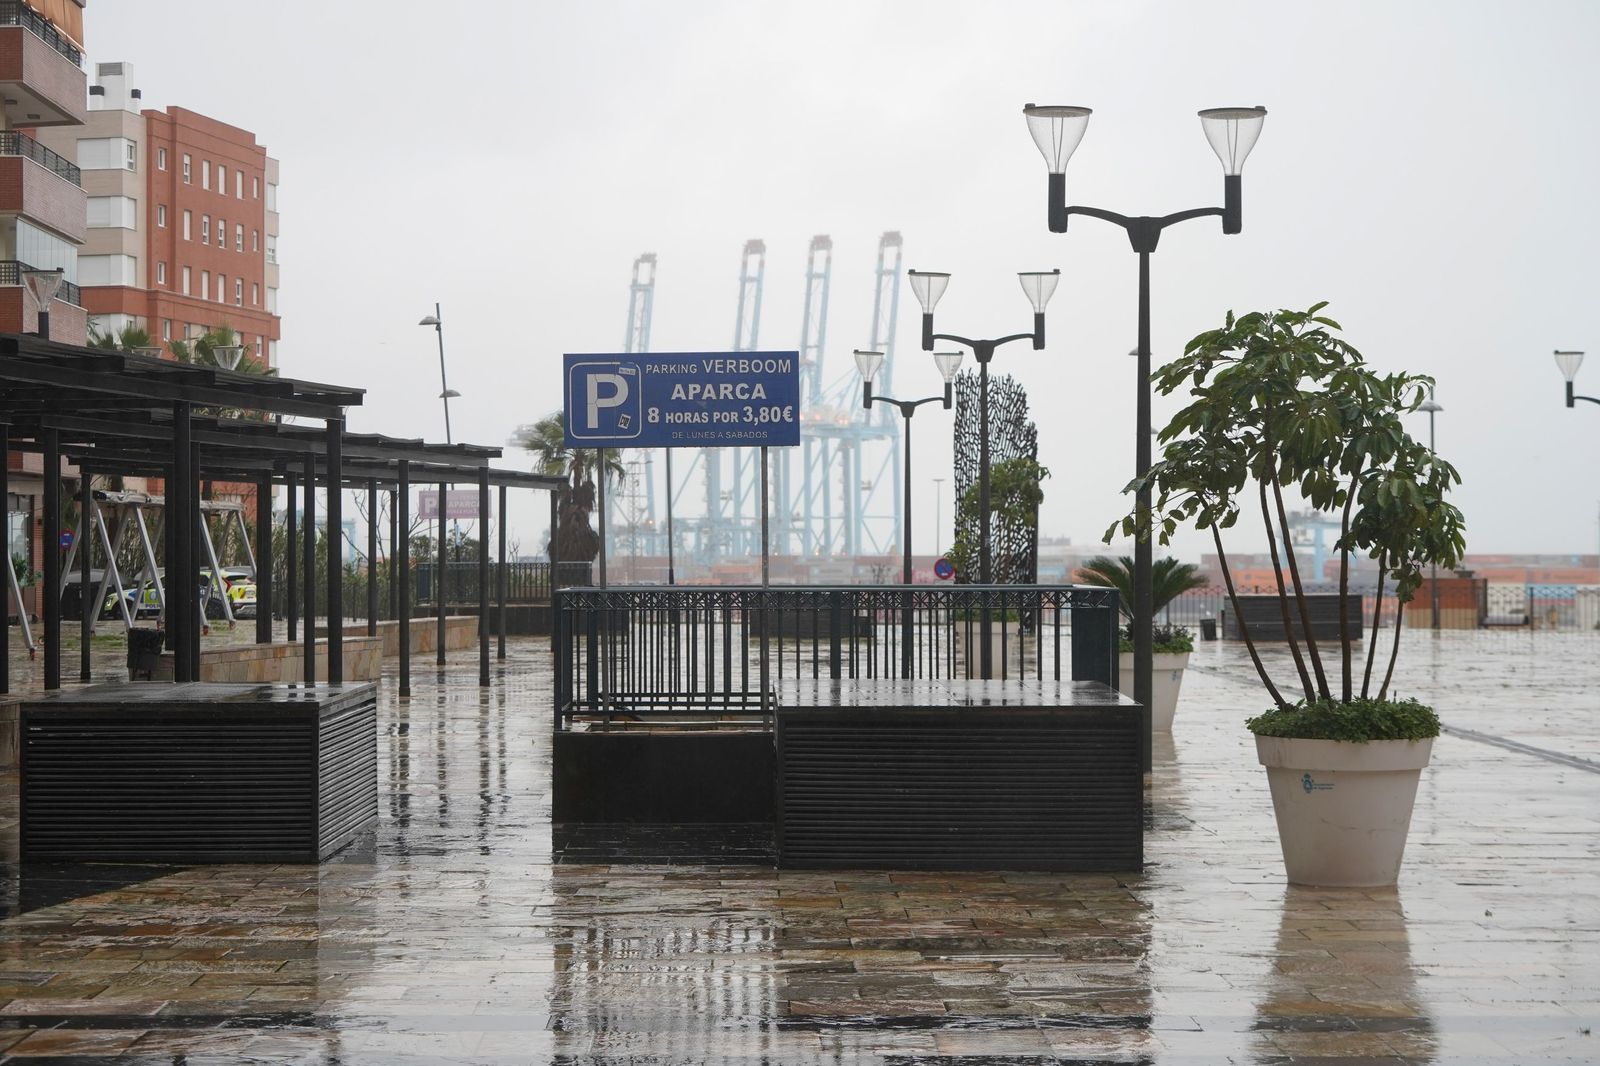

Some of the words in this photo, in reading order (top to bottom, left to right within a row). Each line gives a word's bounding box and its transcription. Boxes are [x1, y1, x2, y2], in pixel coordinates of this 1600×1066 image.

[646, 364, 698, 374] PARKING
[703, 359, 791, 374] VERBOOM
[671, 383, 767, 400] APARCA
[587, 373, 629, 429] P
[647, 407, 660, 423] 8
[665, 412, 709, 423] HORAS
[713, 411, 739, 423] POR
[742, 405, 793, 426] 3,80€
[671, 431, 684, 439] DE
[686, 431, 716, 439] LUNES
[717, 431, 724, 439] A
[725, 431, 768, 439] SABADOS
